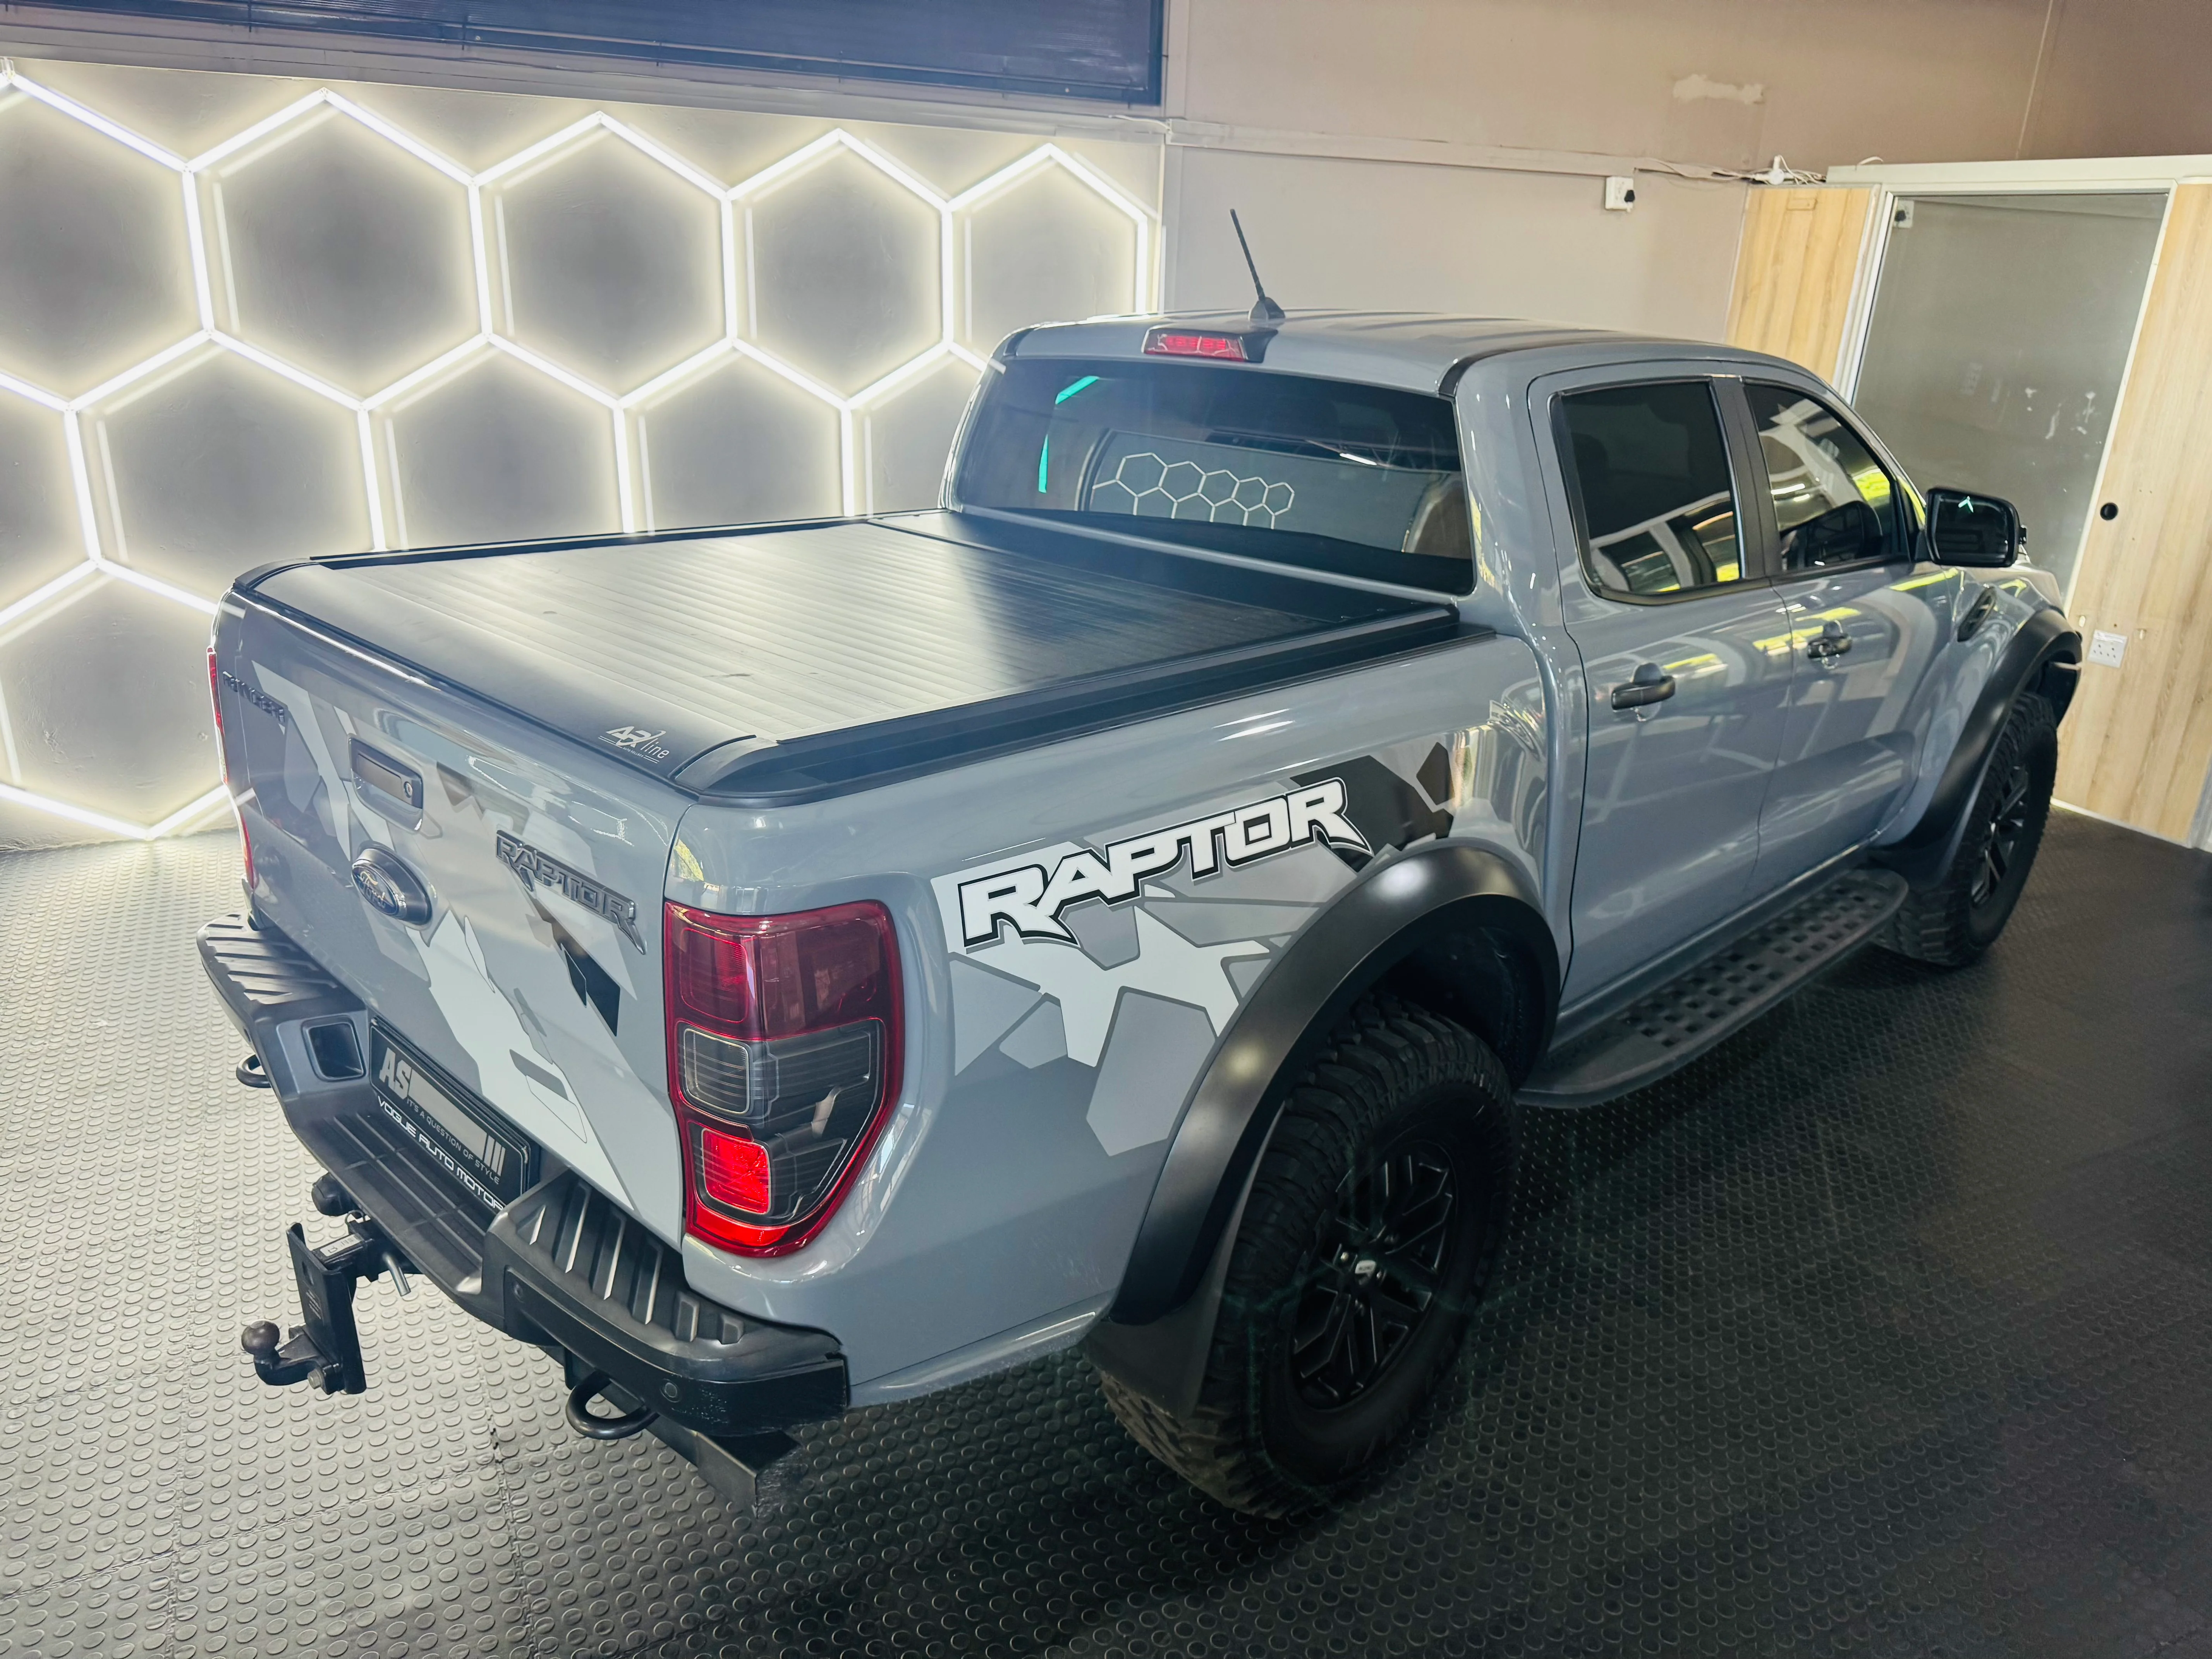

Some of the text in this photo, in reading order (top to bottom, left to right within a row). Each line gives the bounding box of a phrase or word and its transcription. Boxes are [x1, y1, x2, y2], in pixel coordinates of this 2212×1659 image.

[358, 871, 386, 908] Ford
[496, 830, 646, 955] RAPTOR
[958, 777, 1373, 948] RAPTOR
[378, 1096, 416, 1138] VOGUE
[419, 1133, 454, 1171] AUTO
[407, 1098, 500, 1185] IT'S A QUESTION OF STYLE
